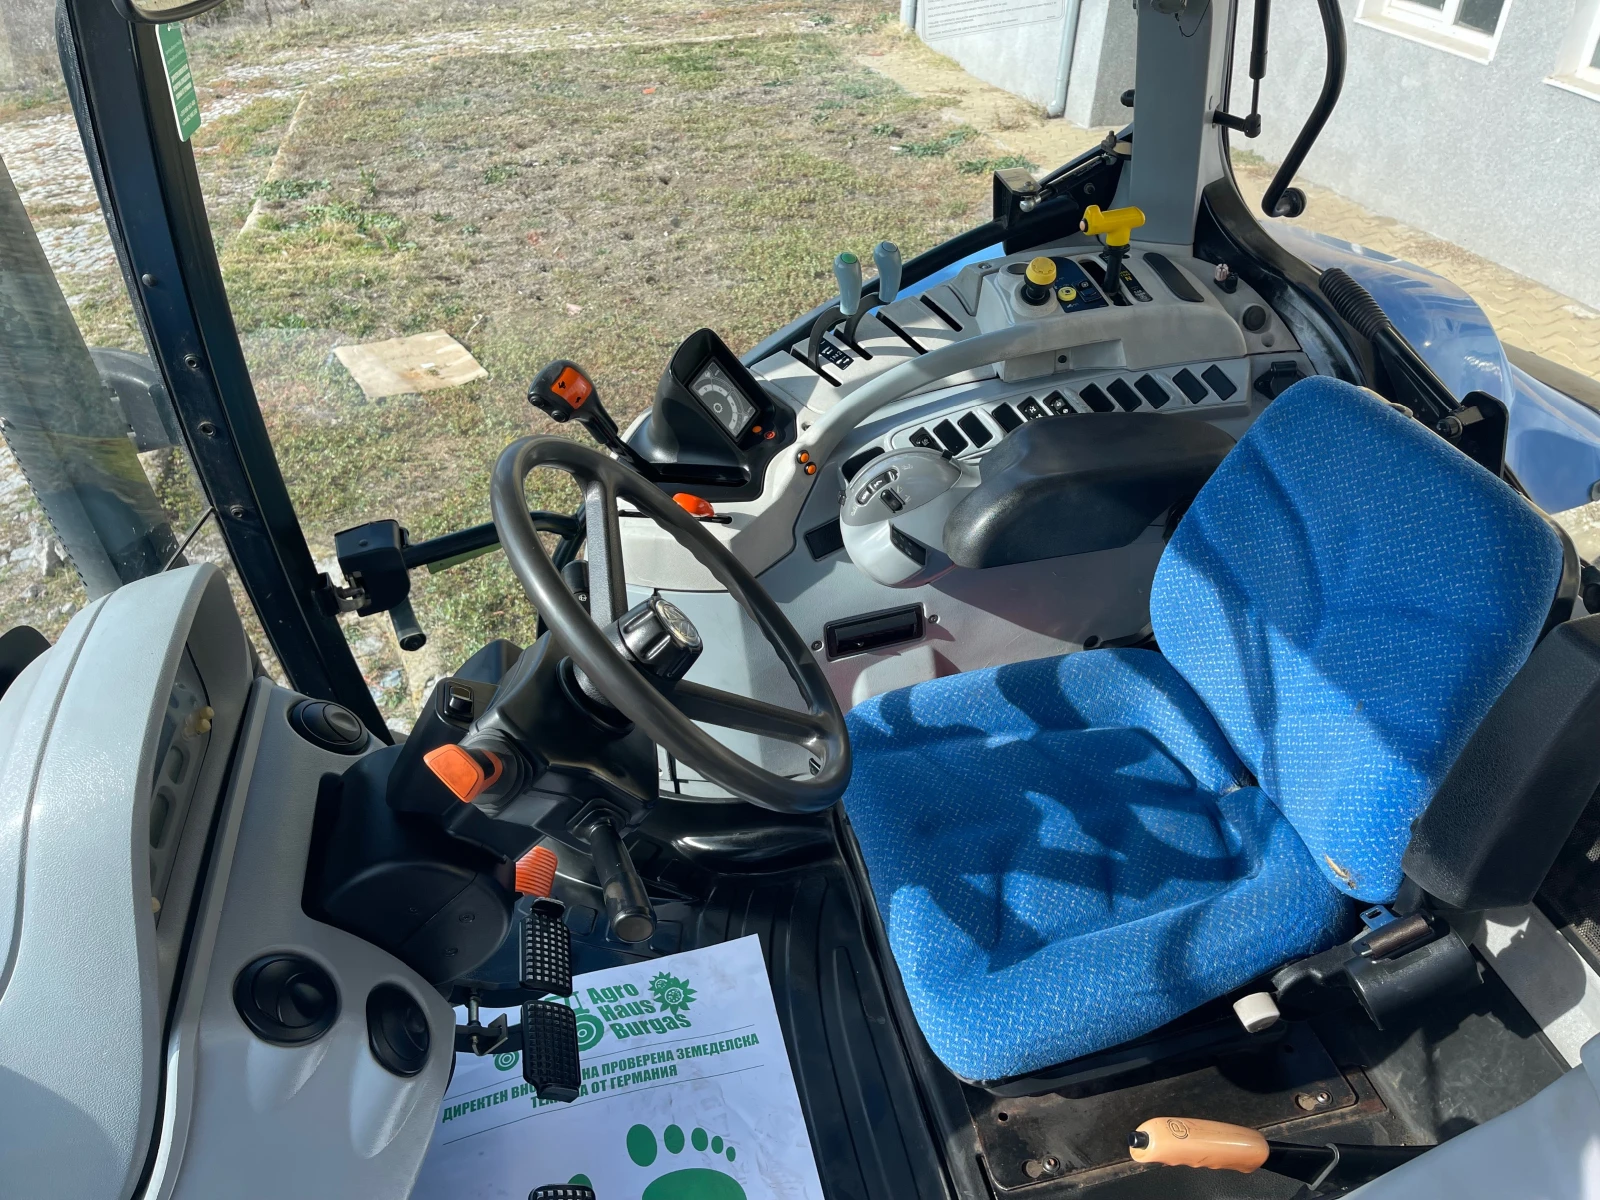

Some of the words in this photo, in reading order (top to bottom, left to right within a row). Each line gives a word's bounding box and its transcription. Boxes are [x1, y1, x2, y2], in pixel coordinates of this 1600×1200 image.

[587, 983, 640, 1004] Agro
[596, 999, 657, 1022] Haus
[609, 1013, 692, 1040] Burgas
[442, 1089, 509, 1124] ДИРЕКТЕН
[582, 1065, 600, 1080] НА
[602, 1049, 675, 1076] ПРОВЕРЕНА
[676, 1033, 760, 1060] ЗЕМЕДЕЛСКА
[591, 1079, 607, 1094] ОТ
[610, 1064, 678, 1090] ГЕРМАНИЯ
